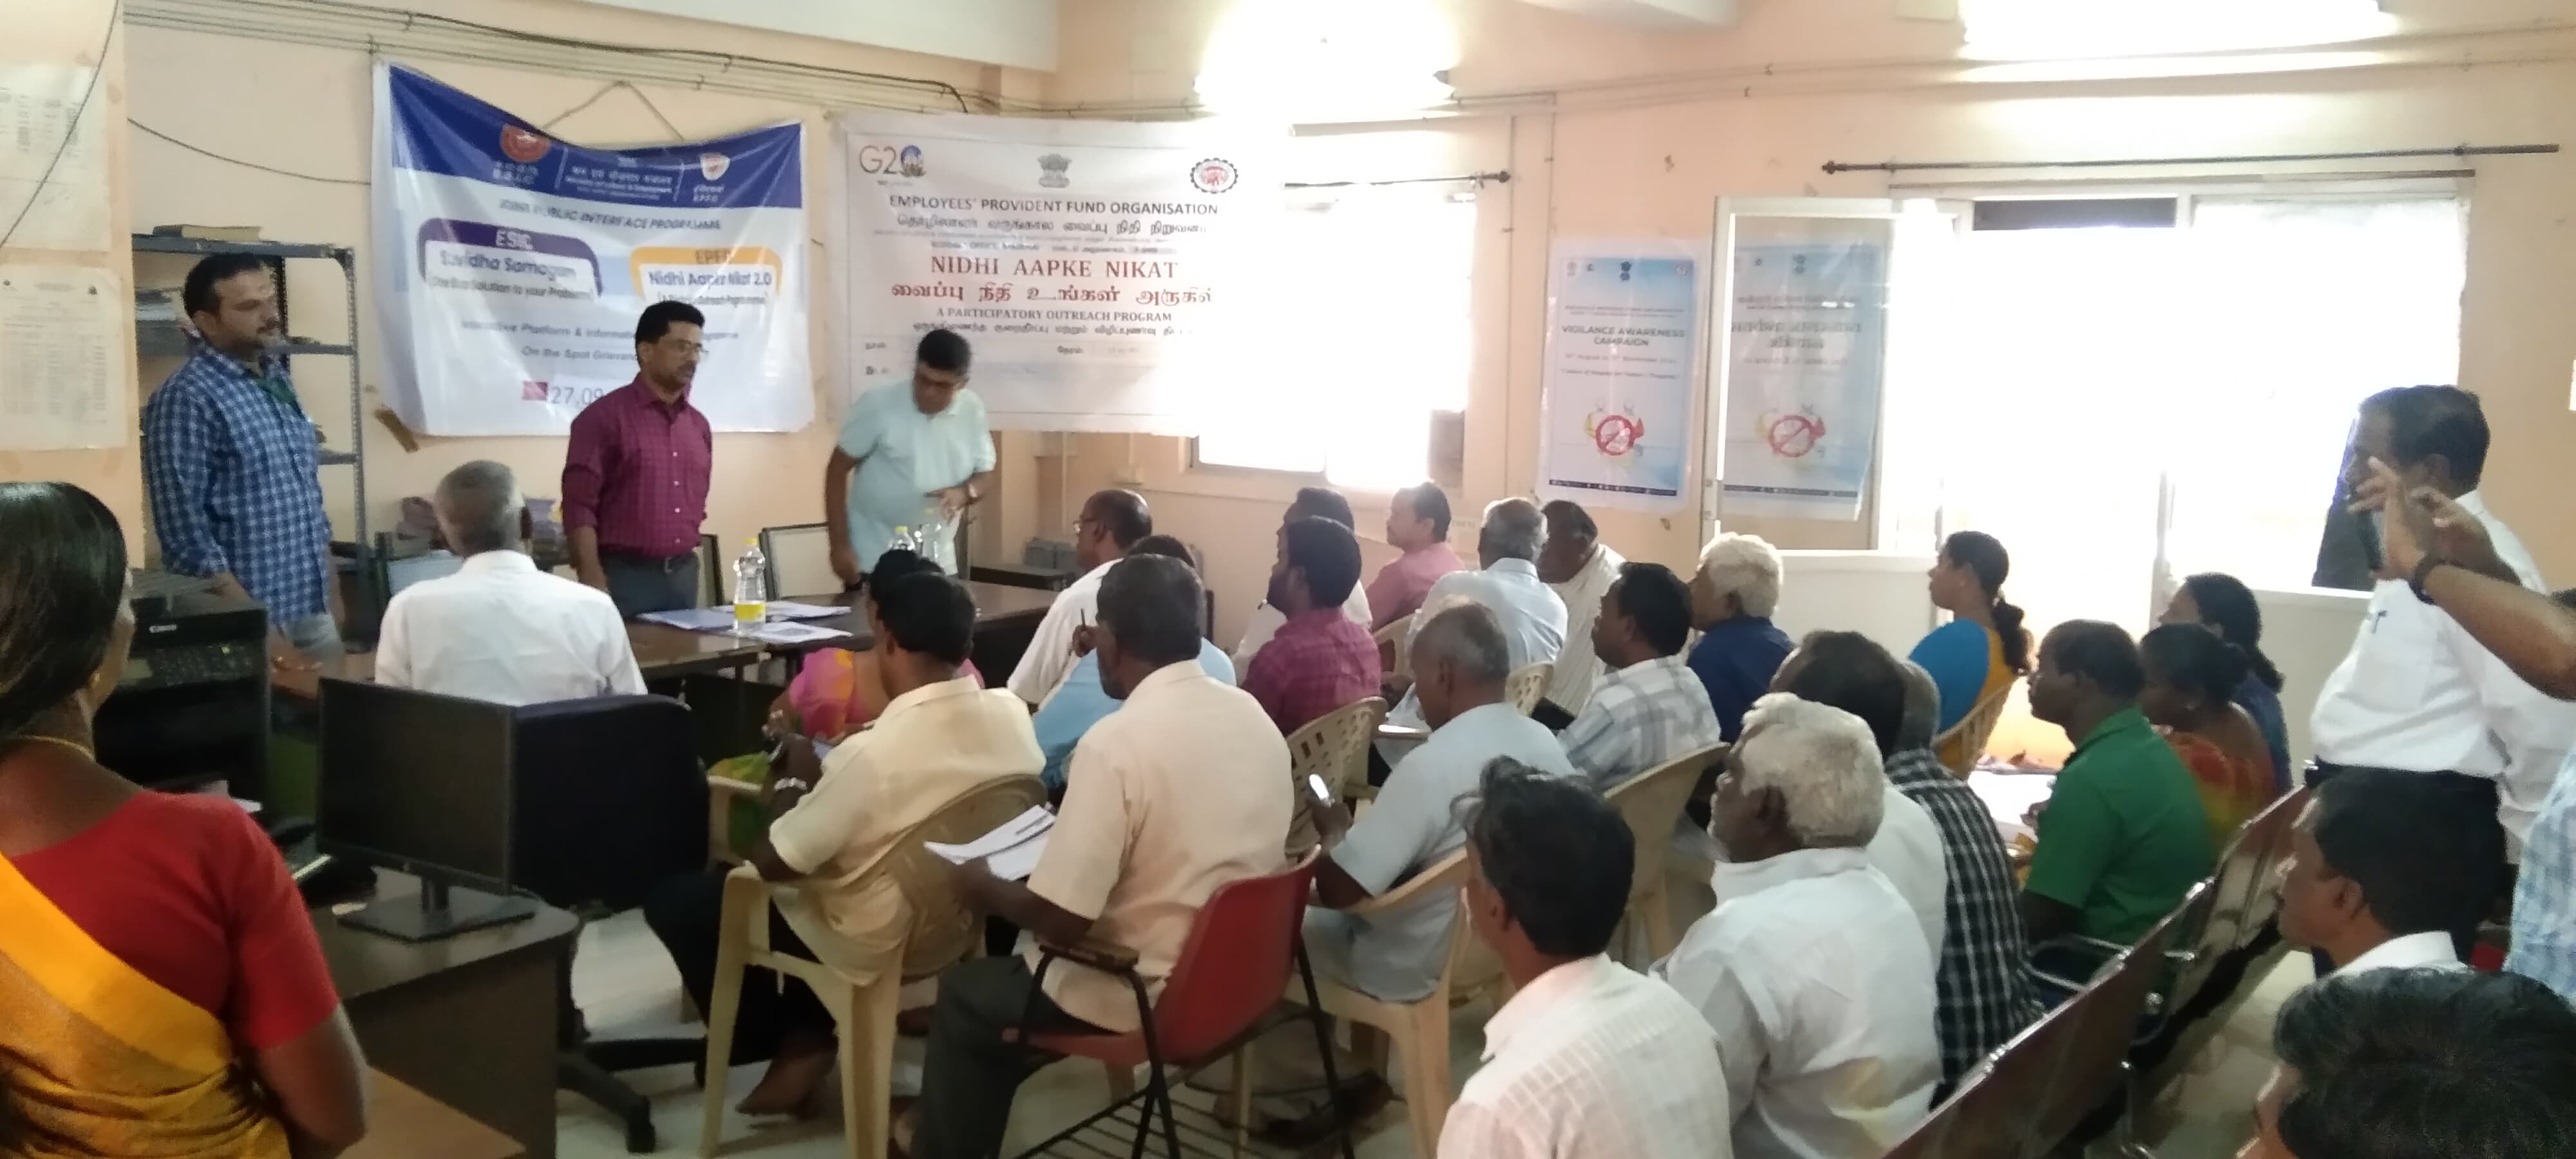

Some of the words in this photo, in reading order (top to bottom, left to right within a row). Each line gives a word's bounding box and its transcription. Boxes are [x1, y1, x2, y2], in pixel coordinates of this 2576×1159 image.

[889, 195, 976, 211] EMPLOYEES'
[981, 199, 1062, 212] PROVIDENT
[1066, 201, 1106, 212] FUND
[1110, 202, 1218, 215] ORGANISATION
[931, 256, 999, 275] NIDHI
[1014, 259, 1092, 277] AAPKE
[1106, 261, 1178, 278] NIKAT
[754, 272, 773, 286] 2.0
[891, 281, 963, 301] வைப்பு
[978, 282, 1014, 303] நிதி
[1027, 284, 1121, 301] உங்கள்
[1135, 287, 1211, 306] அருகில்
[937, 308, 945, 318] A
[947, 308, 1042, 319] PARTICIPATORY
[1046, 310, 1111, 320] OUTREACH
[1113, 311, 1172, 322] PROGRAM
[521, 323, 571, 335] Platform
[574, 326, 582, 336] &
[1562, 325, 1615, 335] VIGILANCE
[1618, 328, 1685, 337] AWARENESS
[1593, 337, 1649, 346] CAMPAIGN
[520, 345, 540, 356] On
[564, 348, 590, 359] Spot
